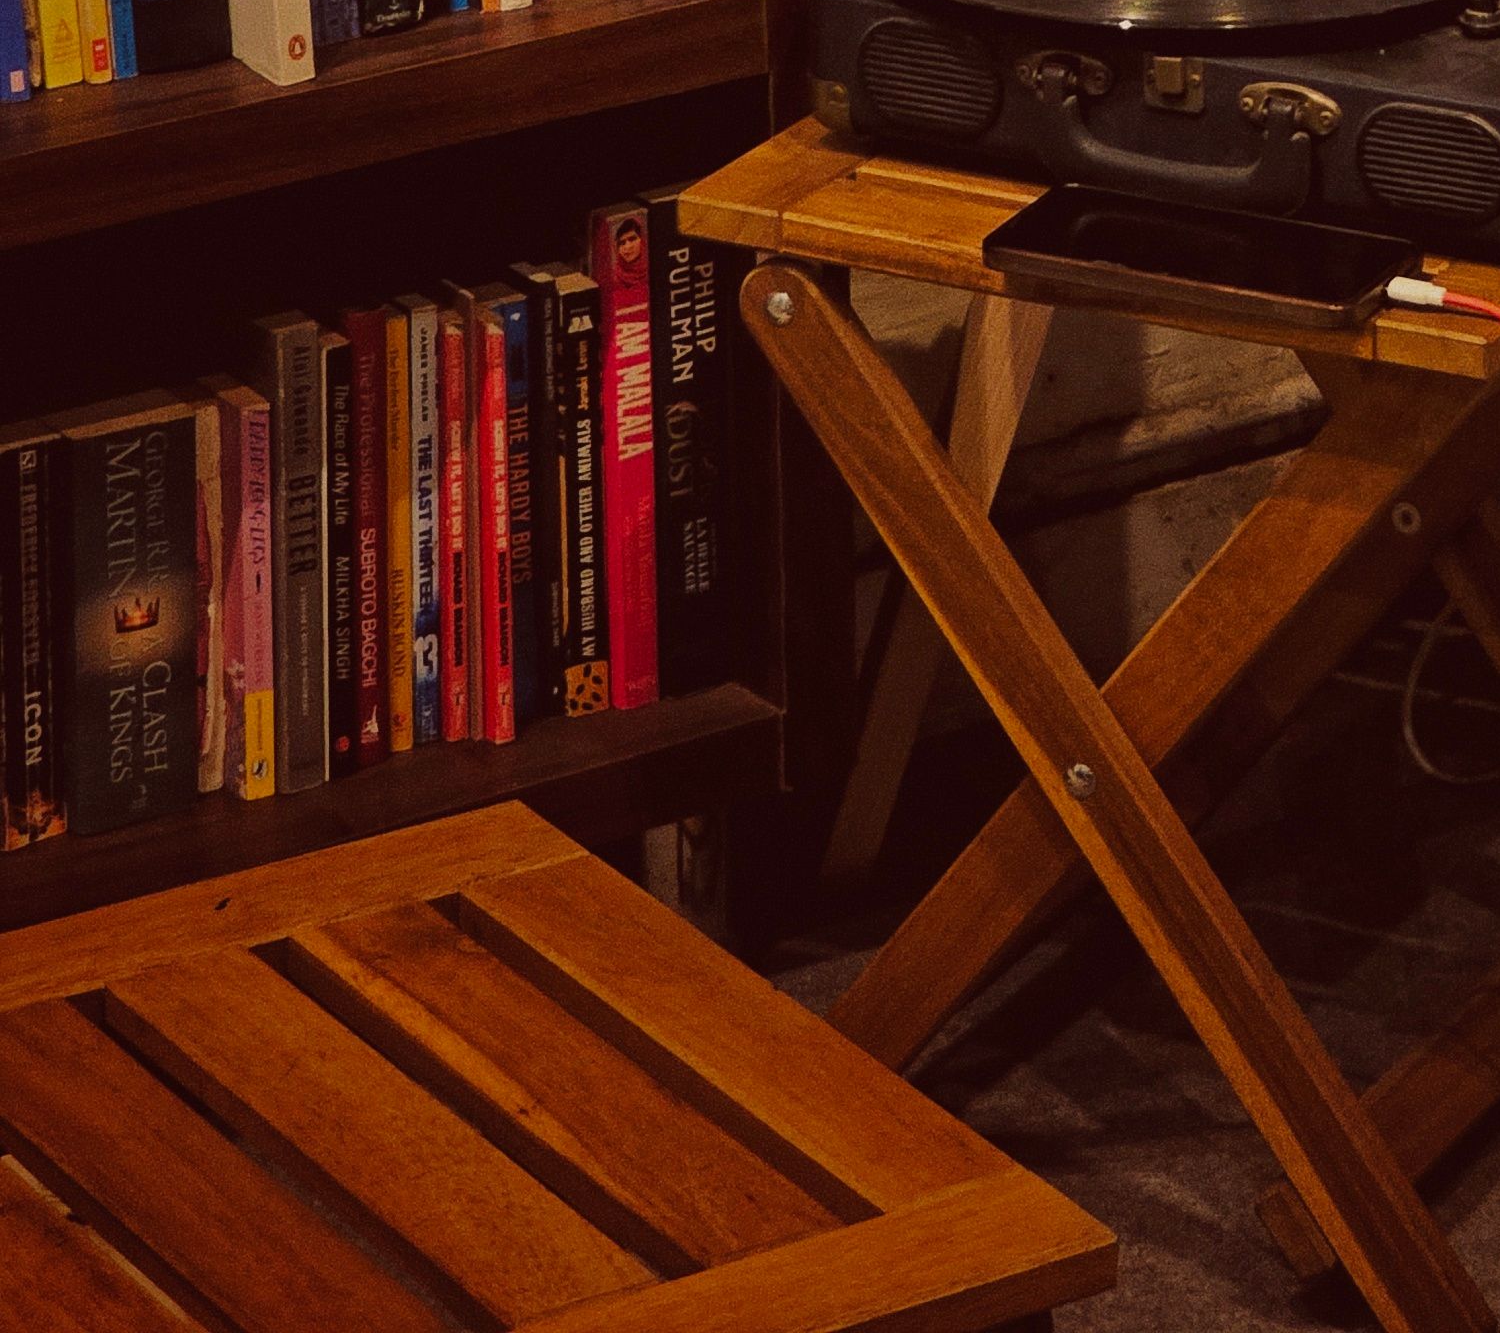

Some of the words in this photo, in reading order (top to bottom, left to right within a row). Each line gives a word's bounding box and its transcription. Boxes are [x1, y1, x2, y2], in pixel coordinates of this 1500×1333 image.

[613, 302, 649, 318] I
[614, 319, 652, 360] AM
[667, 246, 696, 384] PULLMAN
[692, 260, 717, 353] PHILIP
[333, 383, 350, 406] The
[334, 407, 350, 448] Race
[614, 361, 655, 462] MALALA
[332, 470, 350, 496] My
[334, 453, 350, 468] of
[104, 436, 144, 597] MARTIN
[334, 497, 350, 527] Life
[334, 555, 351, 623] MILKHA
[359, 527, 377, 617] SUBROTO
[335, 627, 351, 680] SINGH
[360, 618, 378, 688] BAGCHI
[107, 685, 137, 784] KINGS
[138, 660, 172, 776] CLASH
